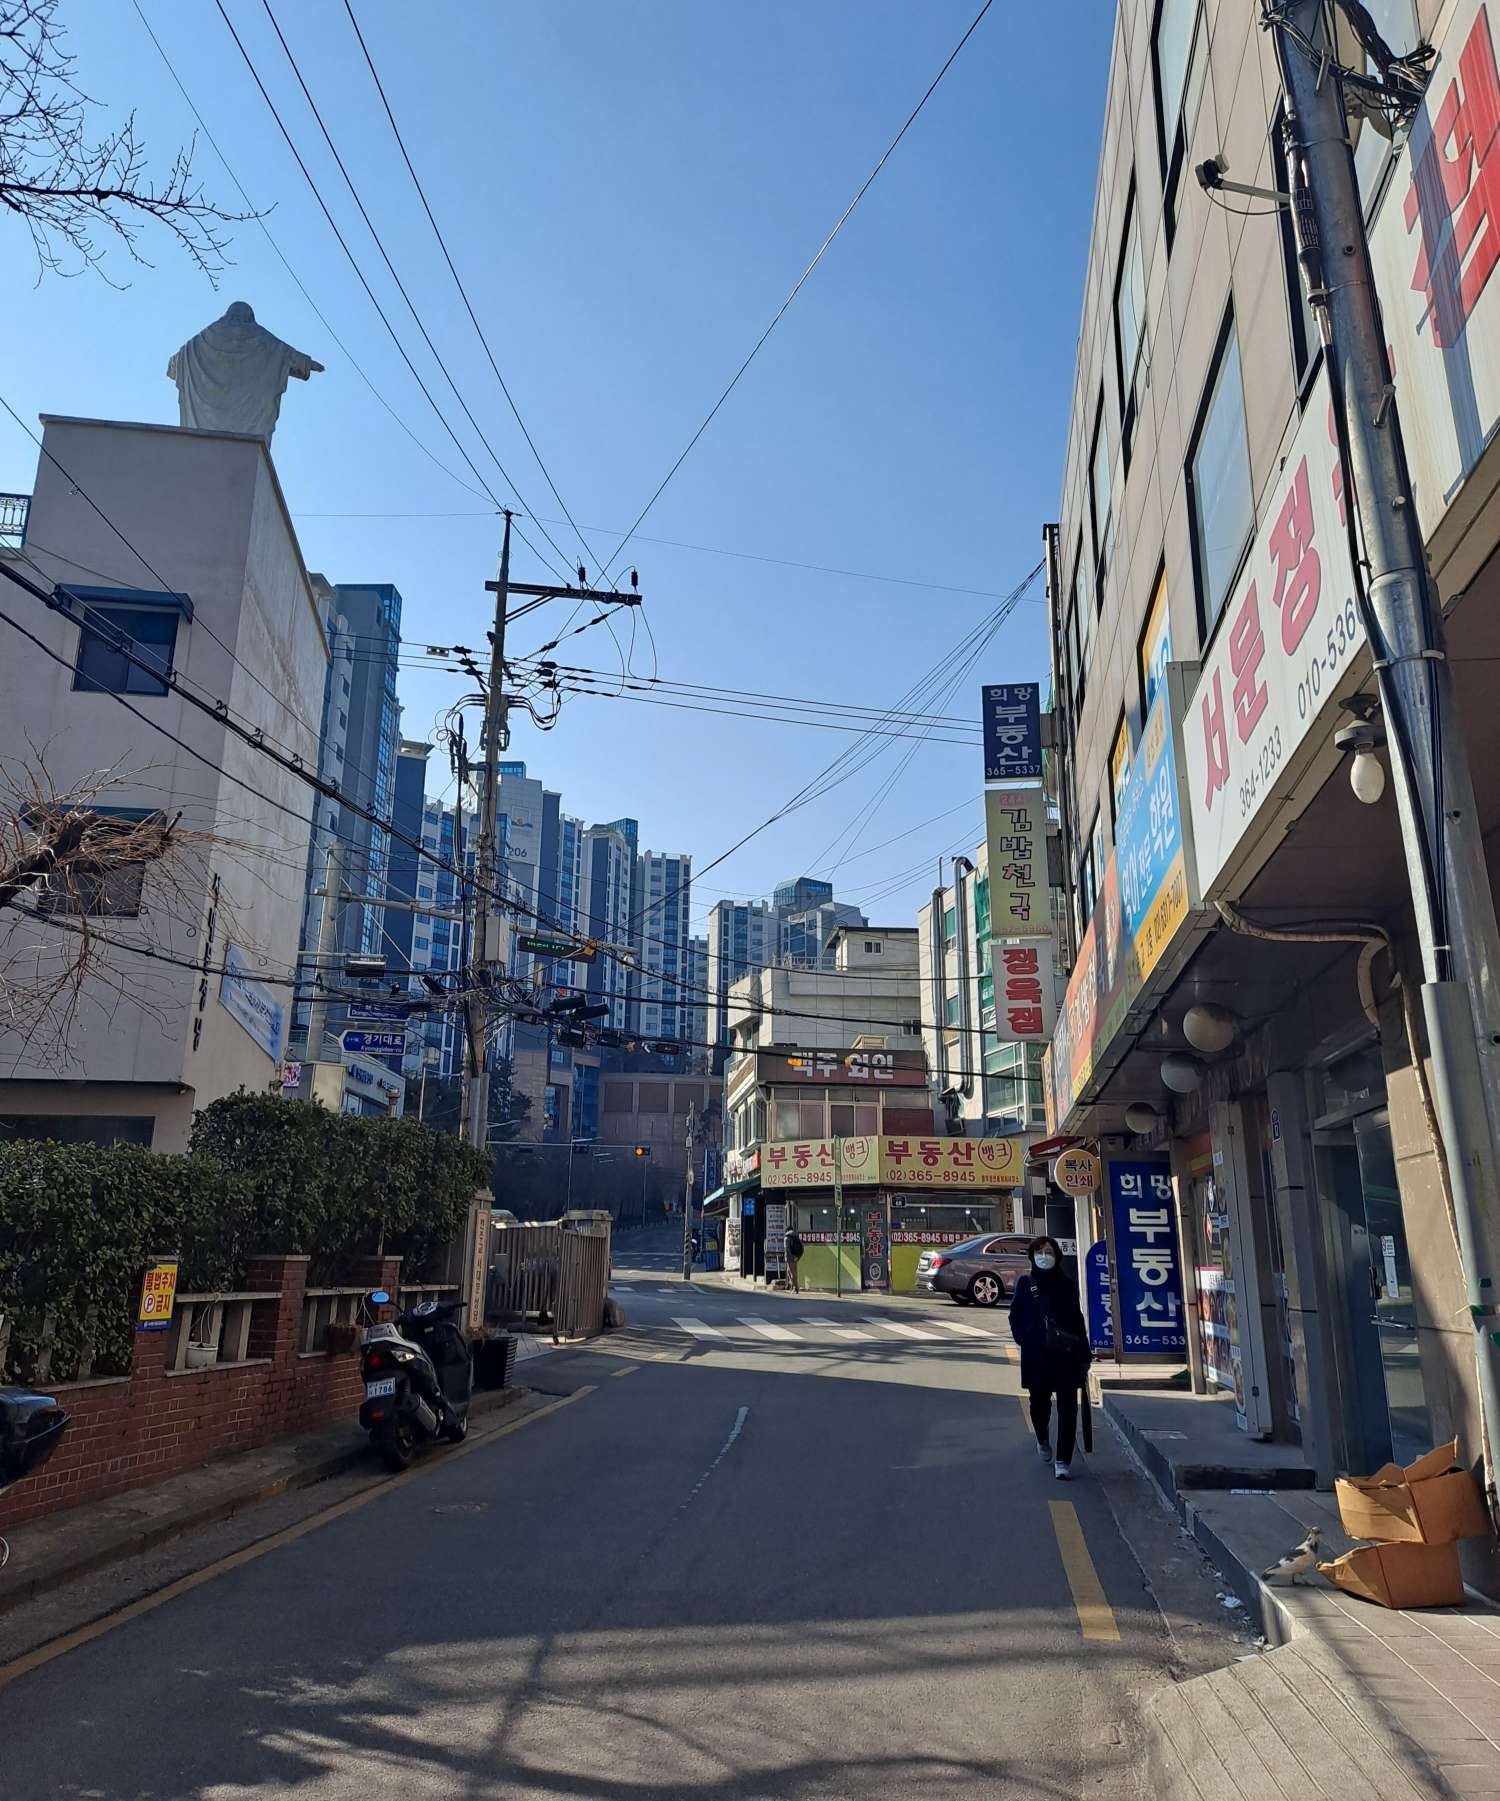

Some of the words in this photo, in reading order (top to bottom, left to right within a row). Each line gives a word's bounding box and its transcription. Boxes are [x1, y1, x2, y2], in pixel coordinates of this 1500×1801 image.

[989, 687, 1033, 701] 희망
[1238, 726, 1283, 818] 364-1233
[1297, 597, 1364, 721] 010-536
[995, 703, 1033, 765] 부동산
[986, 765, 1041, 776] 365-5337
[1000, 808, 1036, 921] 김밥천국
[1002, 948, 1044, 1034] 정육점
[363, 1034, 402, 1046] 경기대로
[845, 1140, 867, 1160] 뱅크
[885, 1140, 976, 1167] 부동산
[981, 1143, 1009, 1161] 뱅크
[1063, 1158, 1093, 1173] 복사
[1065, 1174, 1094, 1188] 인쇄
[864, 1211, 884, 1259] 부동산
[1129, 1207, 1180, 1328] 부동산
[155, 1294, 171, 1313] 금지
